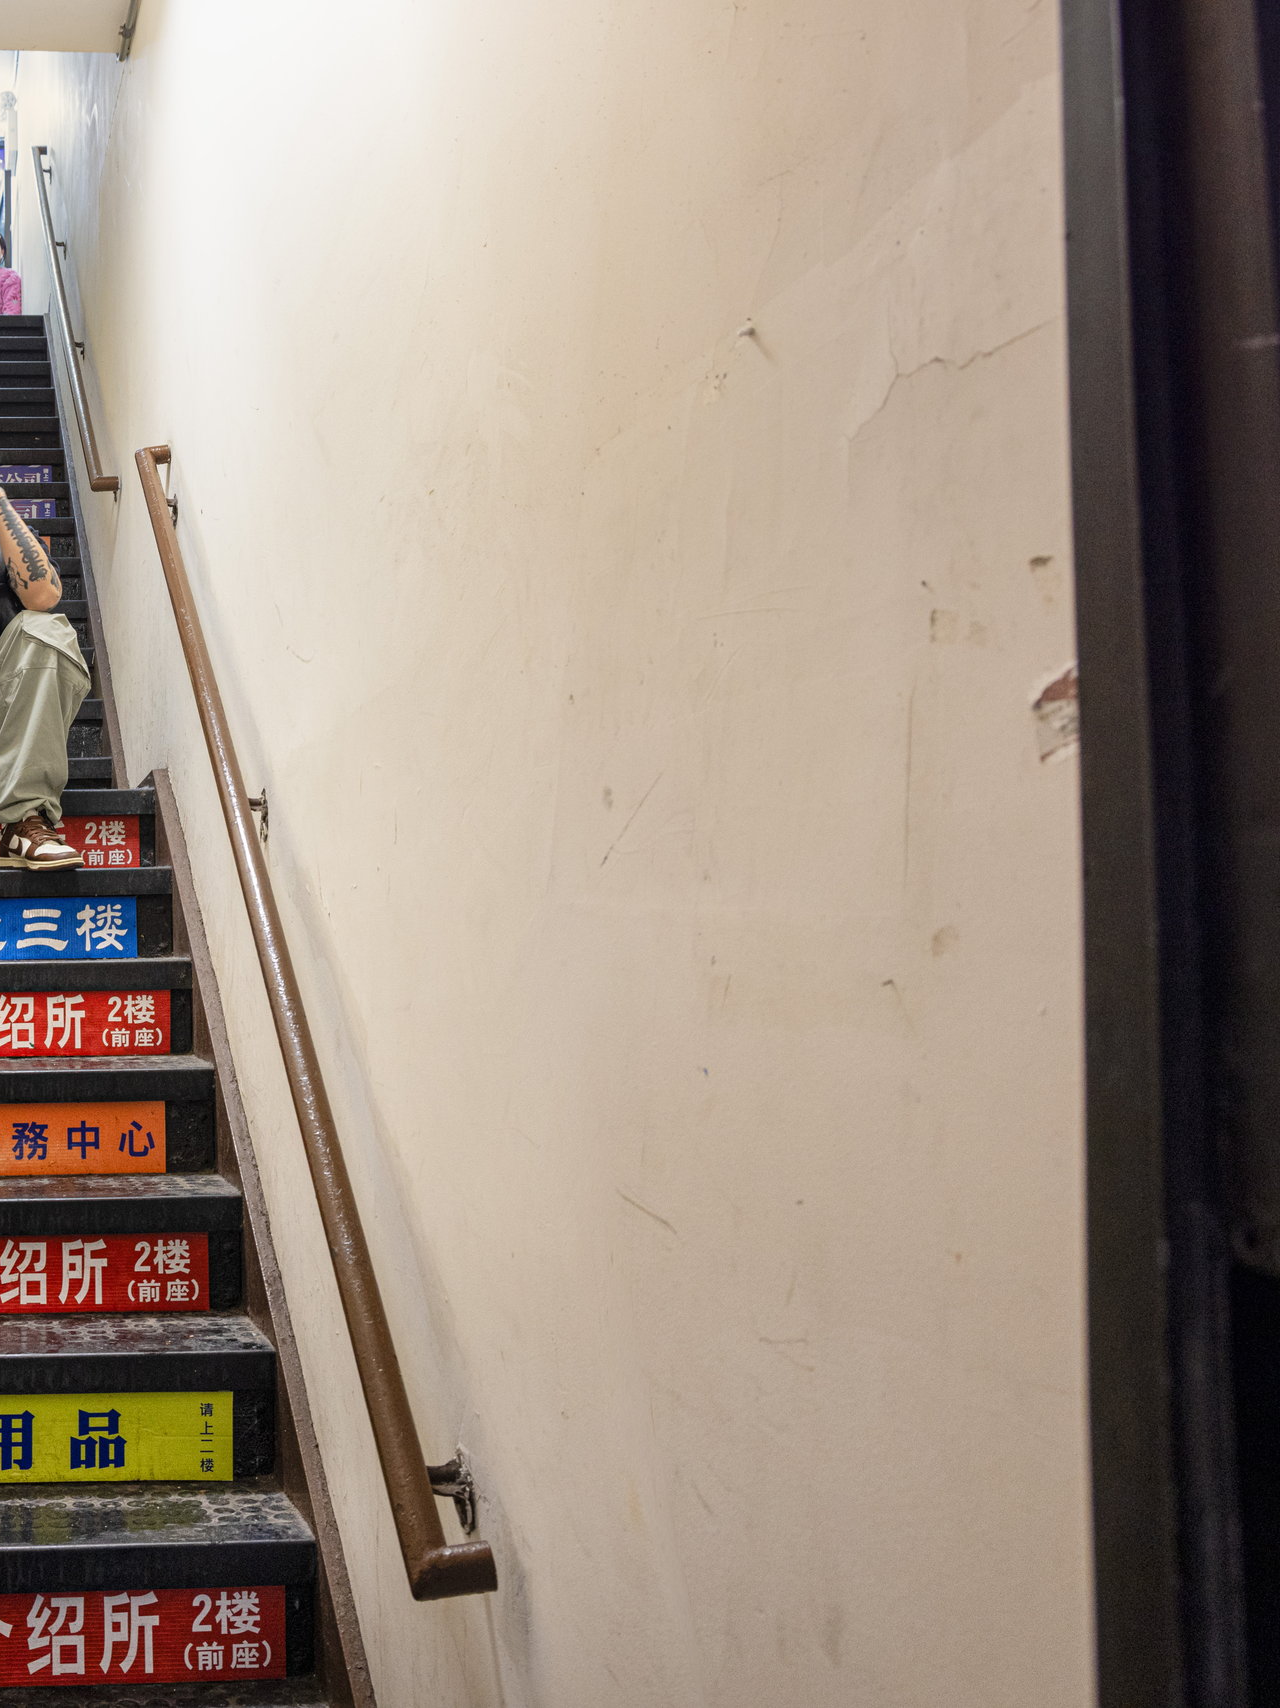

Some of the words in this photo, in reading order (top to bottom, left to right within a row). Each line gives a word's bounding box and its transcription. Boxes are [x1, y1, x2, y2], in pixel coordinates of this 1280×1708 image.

[84, 820, 126, 846] 2楼
[106, 995, 156, 1025] 2楼
[102, 1027, 163, 1049] (前座)
[133, 1239, 191, 1275] 2楼
[126, 1278, 200, 1303] (前座)
[199, 1402, 215, 1473] 请上二楼
[191, 1590, 261, 1636] 2楼
[183, 1639, 272, 1672] (前座)
